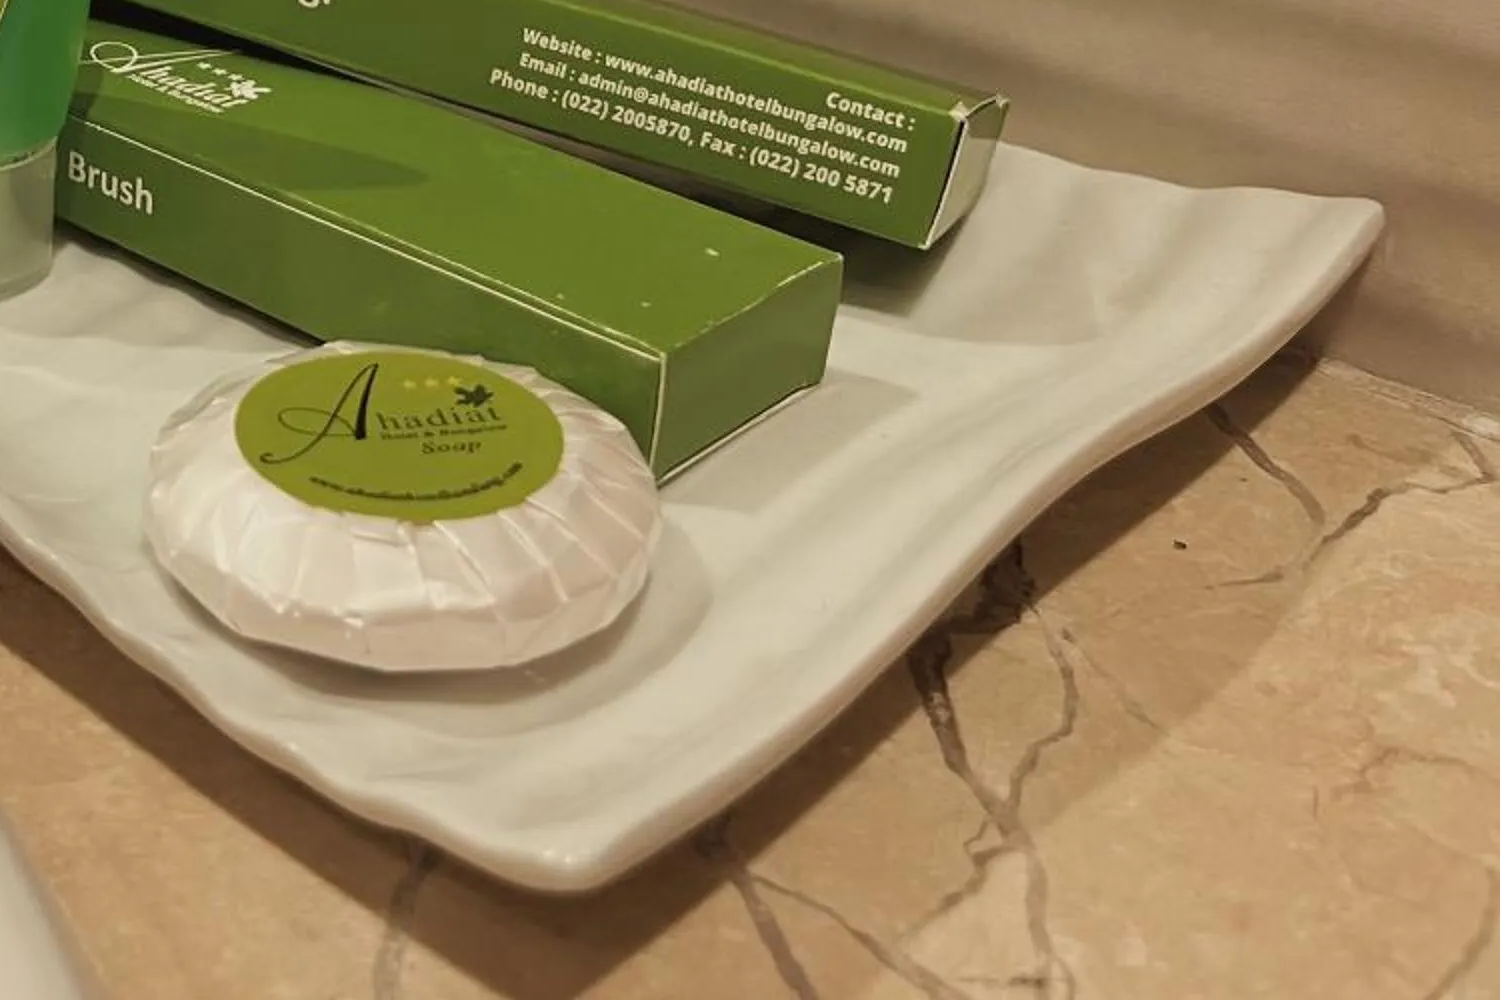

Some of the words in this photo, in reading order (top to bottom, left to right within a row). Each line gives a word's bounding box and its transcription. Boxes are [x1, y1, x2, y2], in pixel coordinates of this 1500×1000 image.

[490, 68, 549, 99] Phone
[561, 89, 610, 120] (022)
[611, 105, 694, 146] 2005870,
[700, 131, 737, 157] Fax
[750, 146, 800, 178] (022)
[803, 163, 841, 187] 200
[843, 174, 893, 205] 5871
[519, 52, 568, 79] Email
[577, 71, 901, 178] admin@ahadiathotelbungalow.com
[522, 28, 592, 61] Website
[605, 54, 908, 153] www.ahadiathotelbungalow.com
[826, 91, 904, 130] Contact
[68, 150, 154, 215] Brush
[259, 363, 503, 465] Ahadiat
[420, 440, 483, 457] Soap
